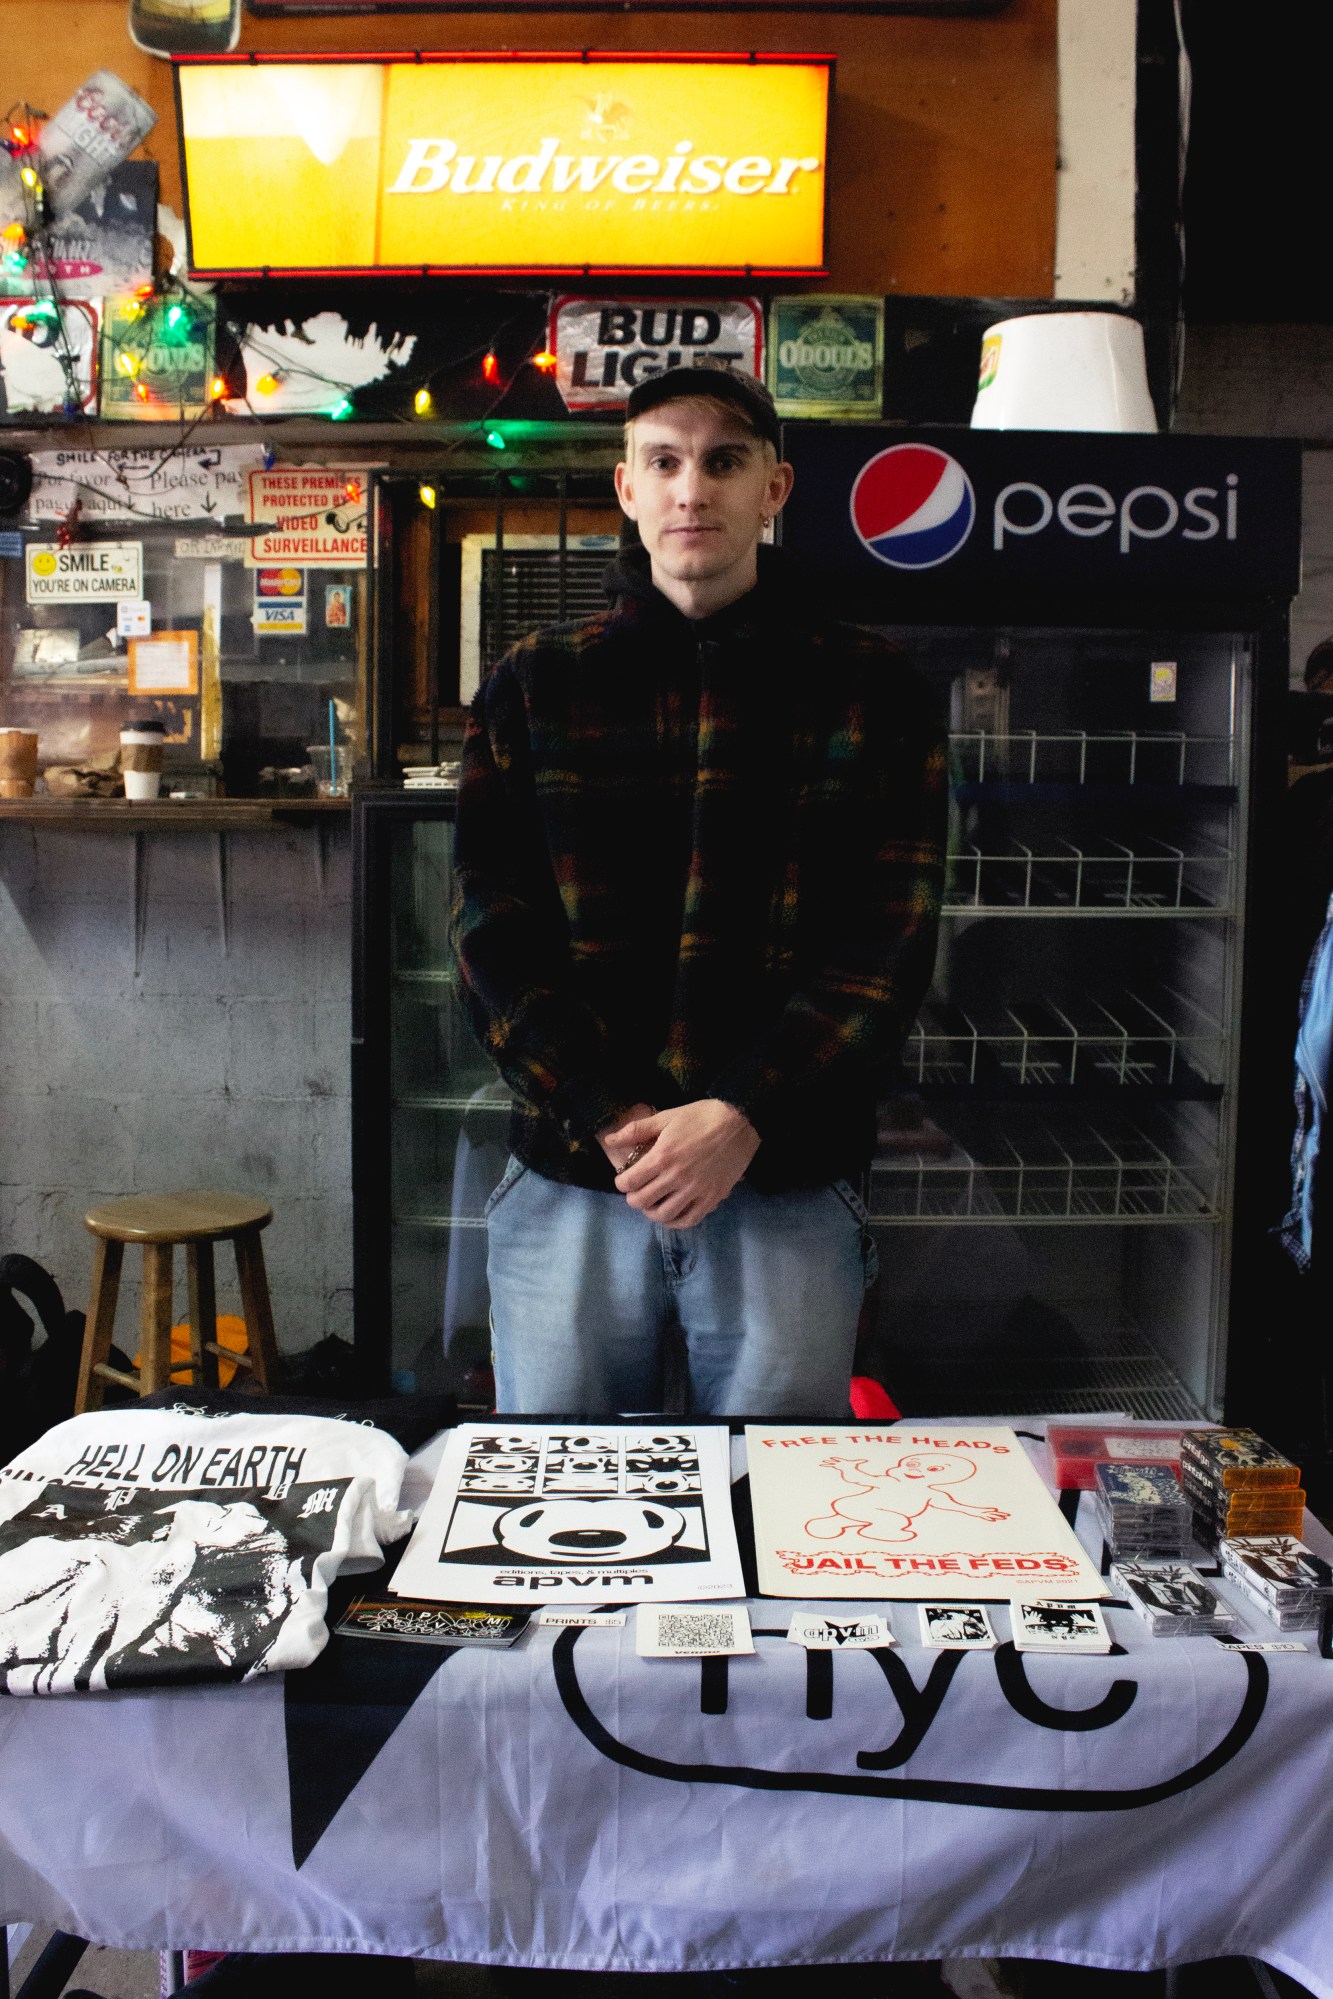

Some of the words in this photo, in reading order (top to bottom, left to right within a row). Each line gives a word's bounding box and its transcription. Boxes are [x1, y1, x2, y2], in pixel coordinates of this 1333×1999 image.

[386, 137, 818, 196] Budweiser
[500, 198, 567, 212] KING
[585, 198, 614, 211] OF
[597, 308, 721, 346] BUD
[150, 470, 208, 489] Please
[262, 477, 298, 489] THESE
[263, 494, 328, 507] PROTECTED
[151, 501, 191, 518] here
[993, 472, 1238, 554] pepsi
[276, 515, 319, 531] VIDEO
[263, 537, 367, 553] SURVEILLANCE
[59, 553, 109, 572] SMILE
[32, 579, 71, 593] YOU'RE
[73, 578, 89, 593] ON
[91, 577, 137, 592] CAMERA
[265, 609, 295, 621] VISA
[762, 1436, 837, 1449] FREE
[846, 1435, 901, 1444] THE
[912, 1436, 1011, 1454] HEADS
[64, 1443, 146, 1482] HELL
[152, 1443, 204, 1484] ON
[200, 1444, 307, 1487] EARTH
[795, 1556, 876, 1570] JAIL
[884, 1557, 966, 1570] THE
[967, 1557, 1069, 1571] FEDS
[500, 1568, 547, 1576] editions,
[549, 1568, 584, 1577] tapes,
[597, 1568, 649, 1576] multiples
[492, 1574, 654, 1590] apvm
[546, 1617, 597, 1625] PRINTS
